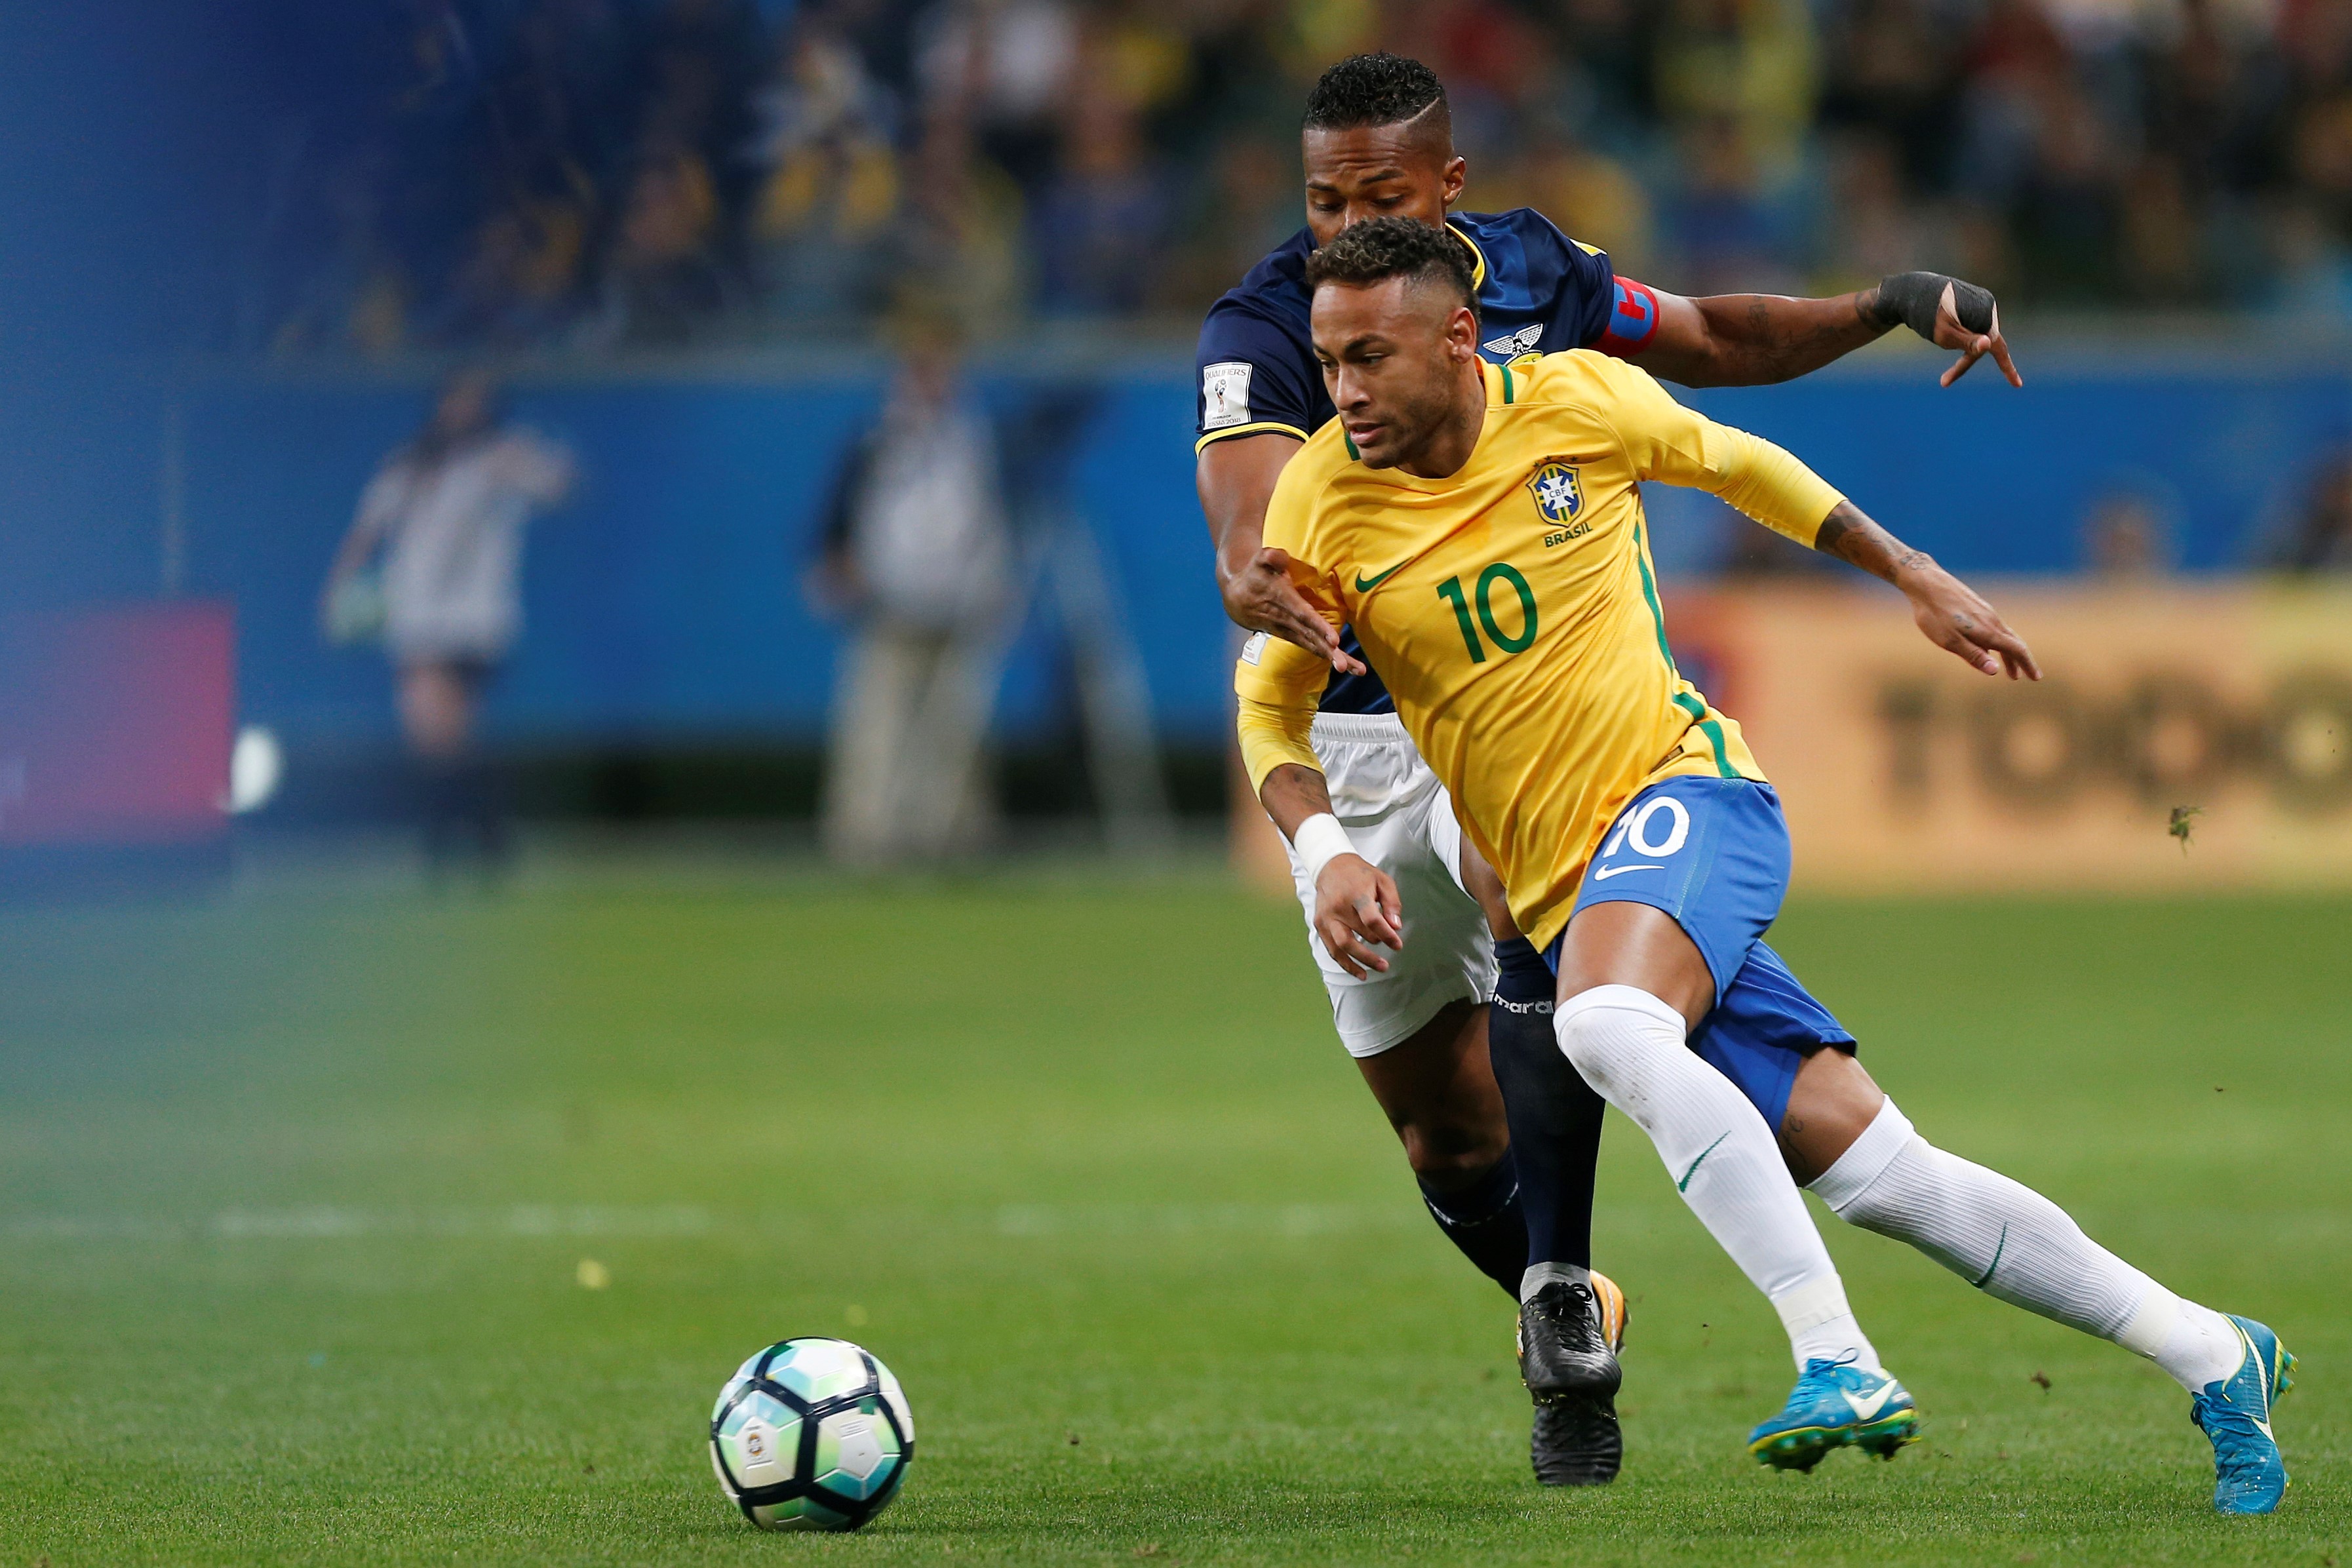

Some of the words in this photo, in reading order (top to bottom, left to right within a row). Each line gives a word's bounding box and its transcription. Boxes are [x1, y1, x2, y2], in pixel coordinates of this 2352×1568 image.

[1205, 368, 1247, 381] QUALIFIERS
[1548, 487, 1567, 498] CBF
[1544, 522, 1594, 548] BRASIL
[1436, 562, 1538, 664] 10
[1603, 796, 1691, 858] 10
